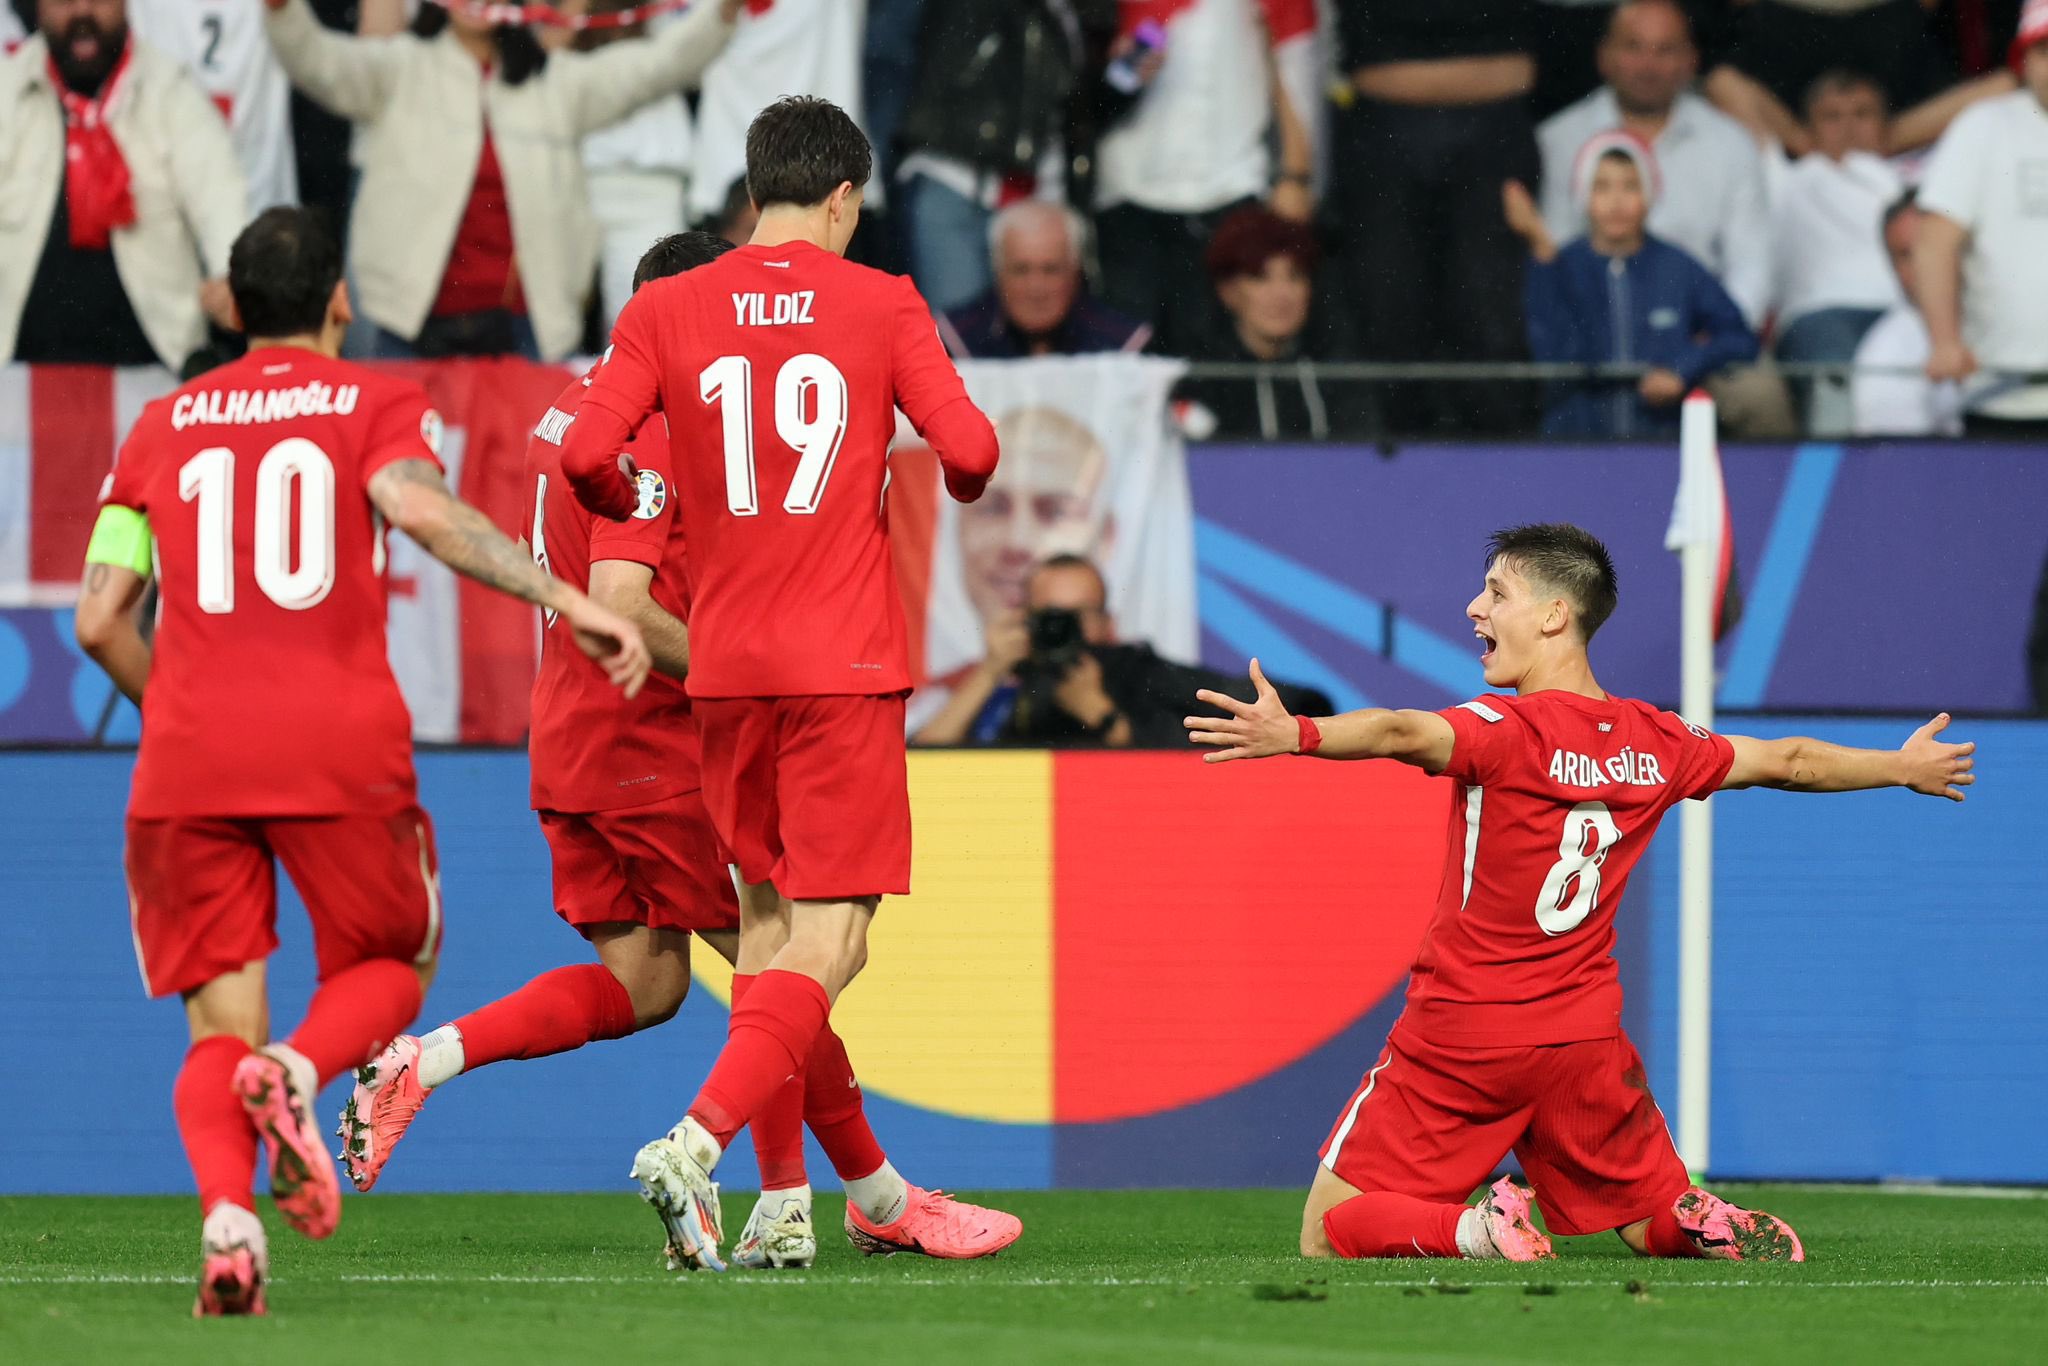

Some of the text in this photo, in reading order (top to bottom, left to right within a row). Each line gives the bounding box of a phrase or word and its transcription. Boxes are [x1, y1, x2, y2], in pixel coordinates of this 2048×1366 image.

[732, 290, 815, 326] YILDIZ
[171, 380, 360, 431] ÇALHANOĞLU
[699, 353, 848, 516] 19
[179, 437, 336, 614] 10
[1549, 745, 1667, 788] ARDA GÜLER
[1534, 800, 1623, 937] 8
